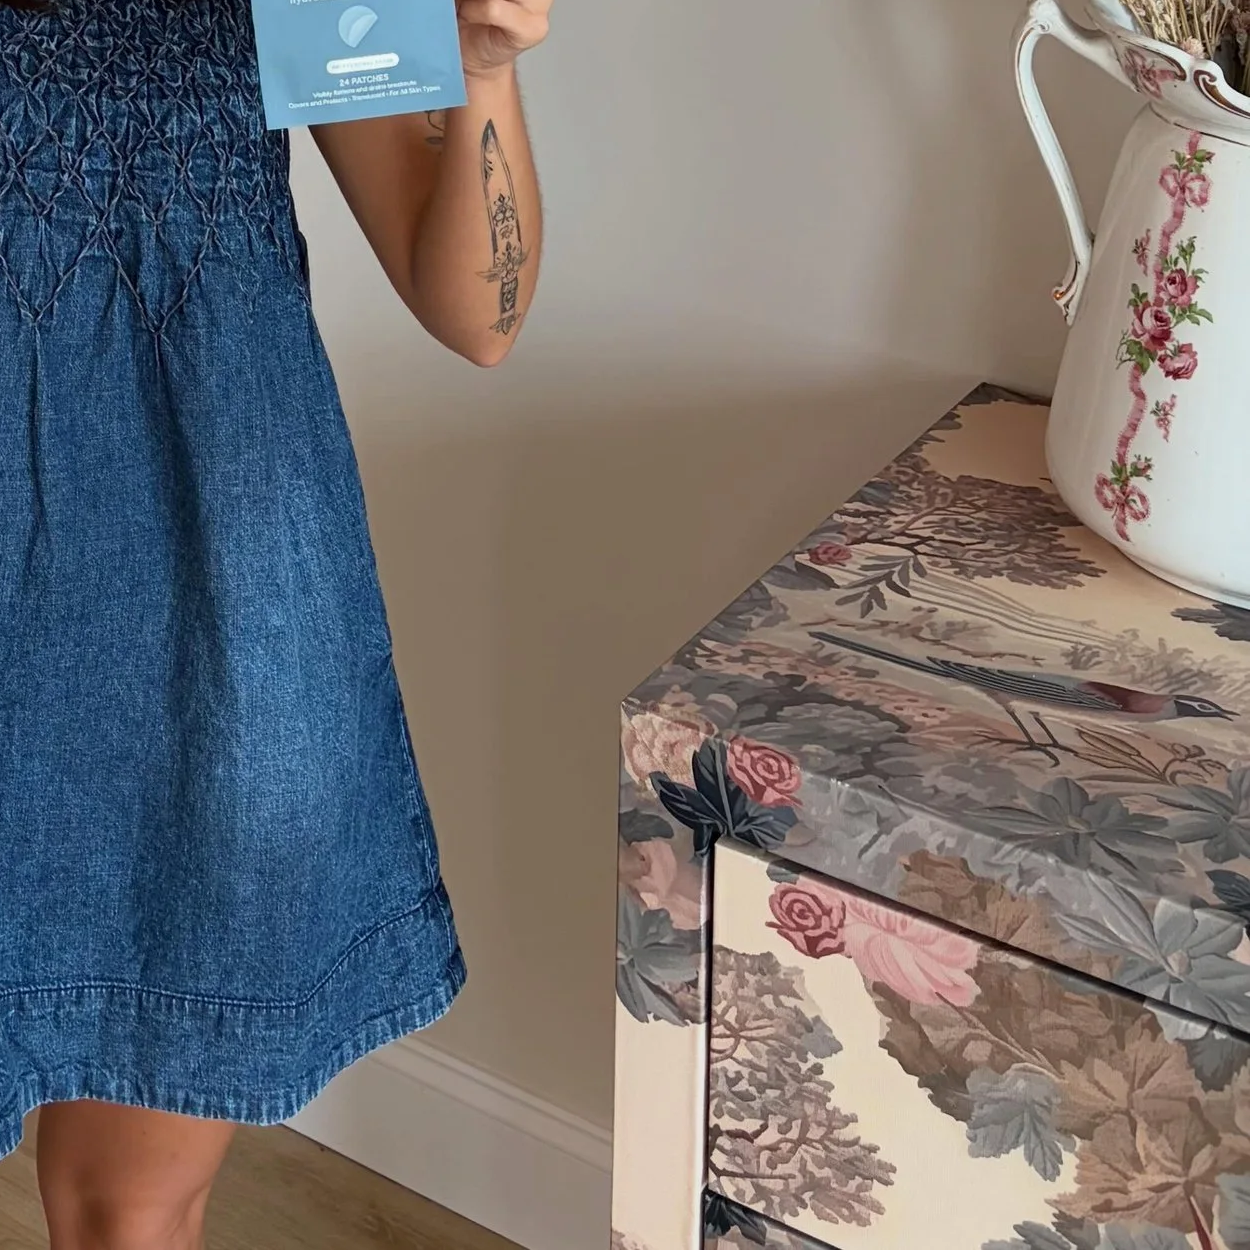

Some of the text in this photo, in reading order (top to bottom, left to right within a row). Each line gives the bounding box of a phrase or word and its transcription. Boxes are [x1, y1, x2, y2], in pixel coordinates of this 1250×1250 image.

[339, 73, 389, 87] 24 PATCHES
[409, 86, 422, 94] Skin
[422, 85, 441, 93] Types
